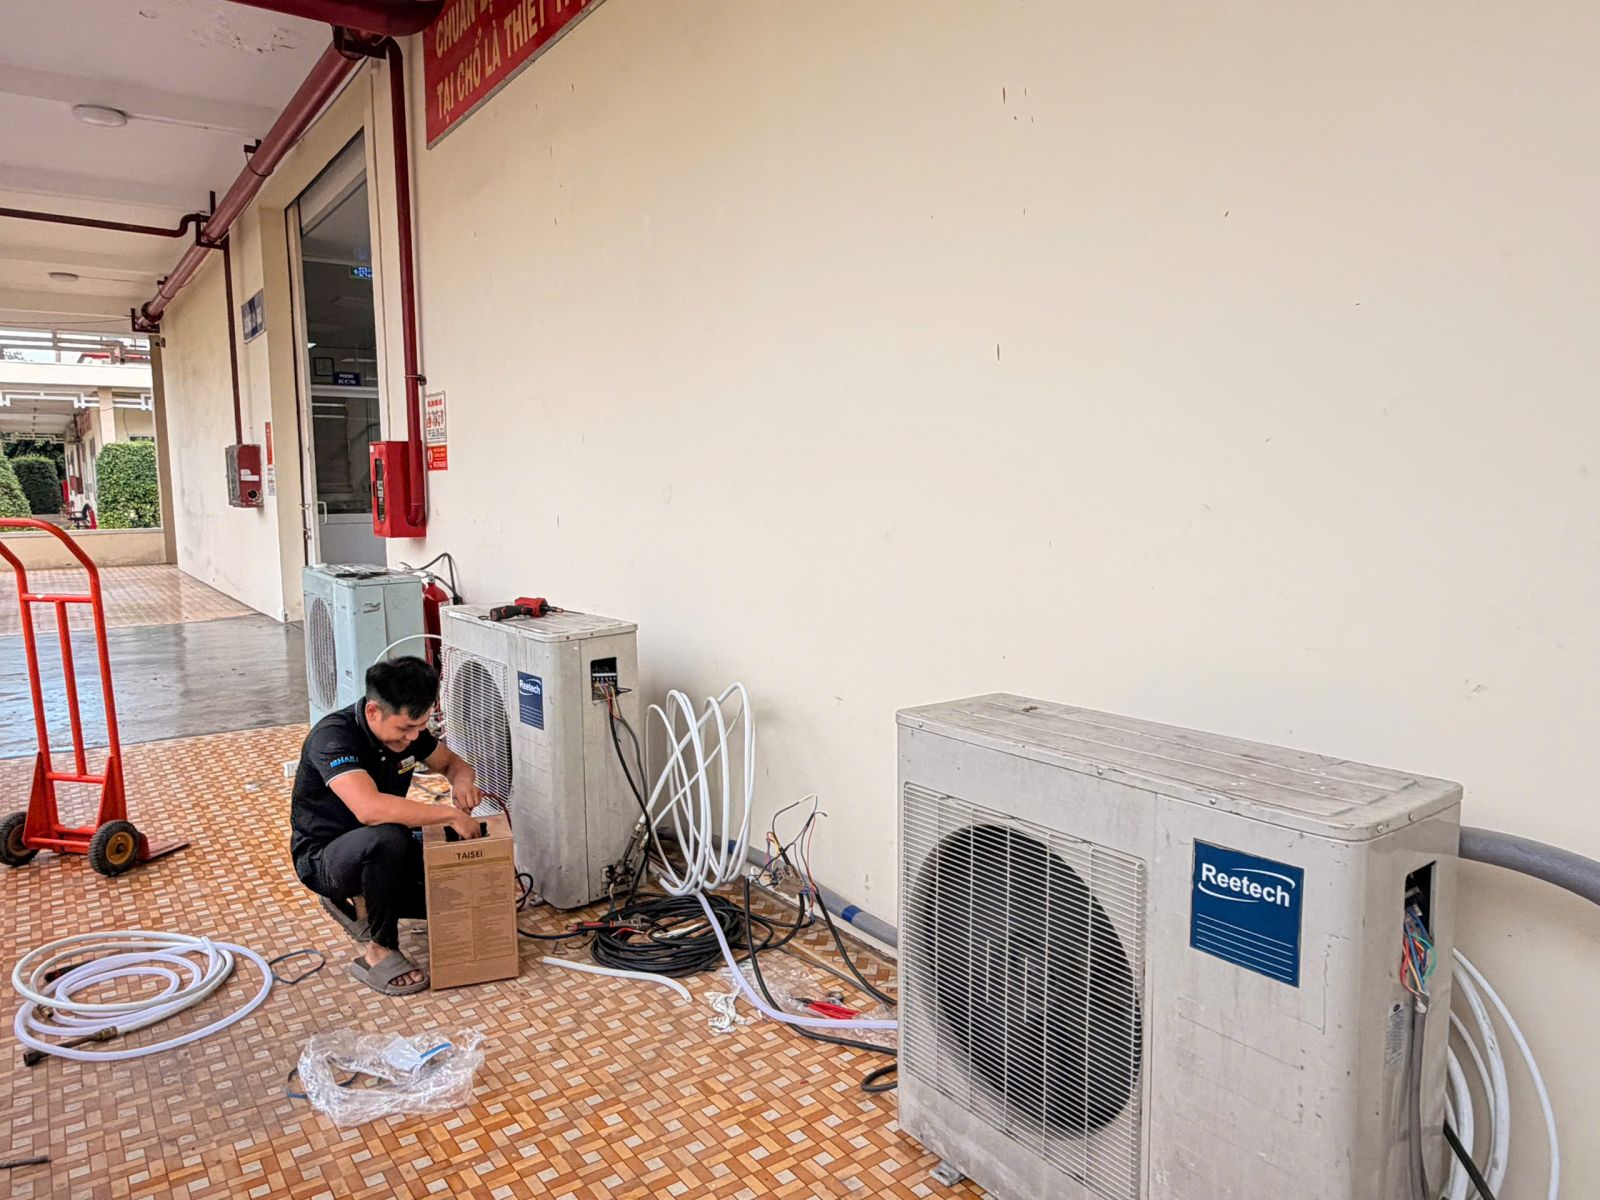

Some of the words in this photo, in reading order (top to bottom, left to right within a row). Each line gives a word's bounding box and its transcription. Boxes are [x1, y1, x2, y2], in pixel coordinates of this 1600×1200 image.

[437, 72, 454, 124] TẠI
[484, 20, 501, 78] LÀ
[456, 850, 483, 861] TAISEI
[1201, 862, 1290, 908] Reetech
